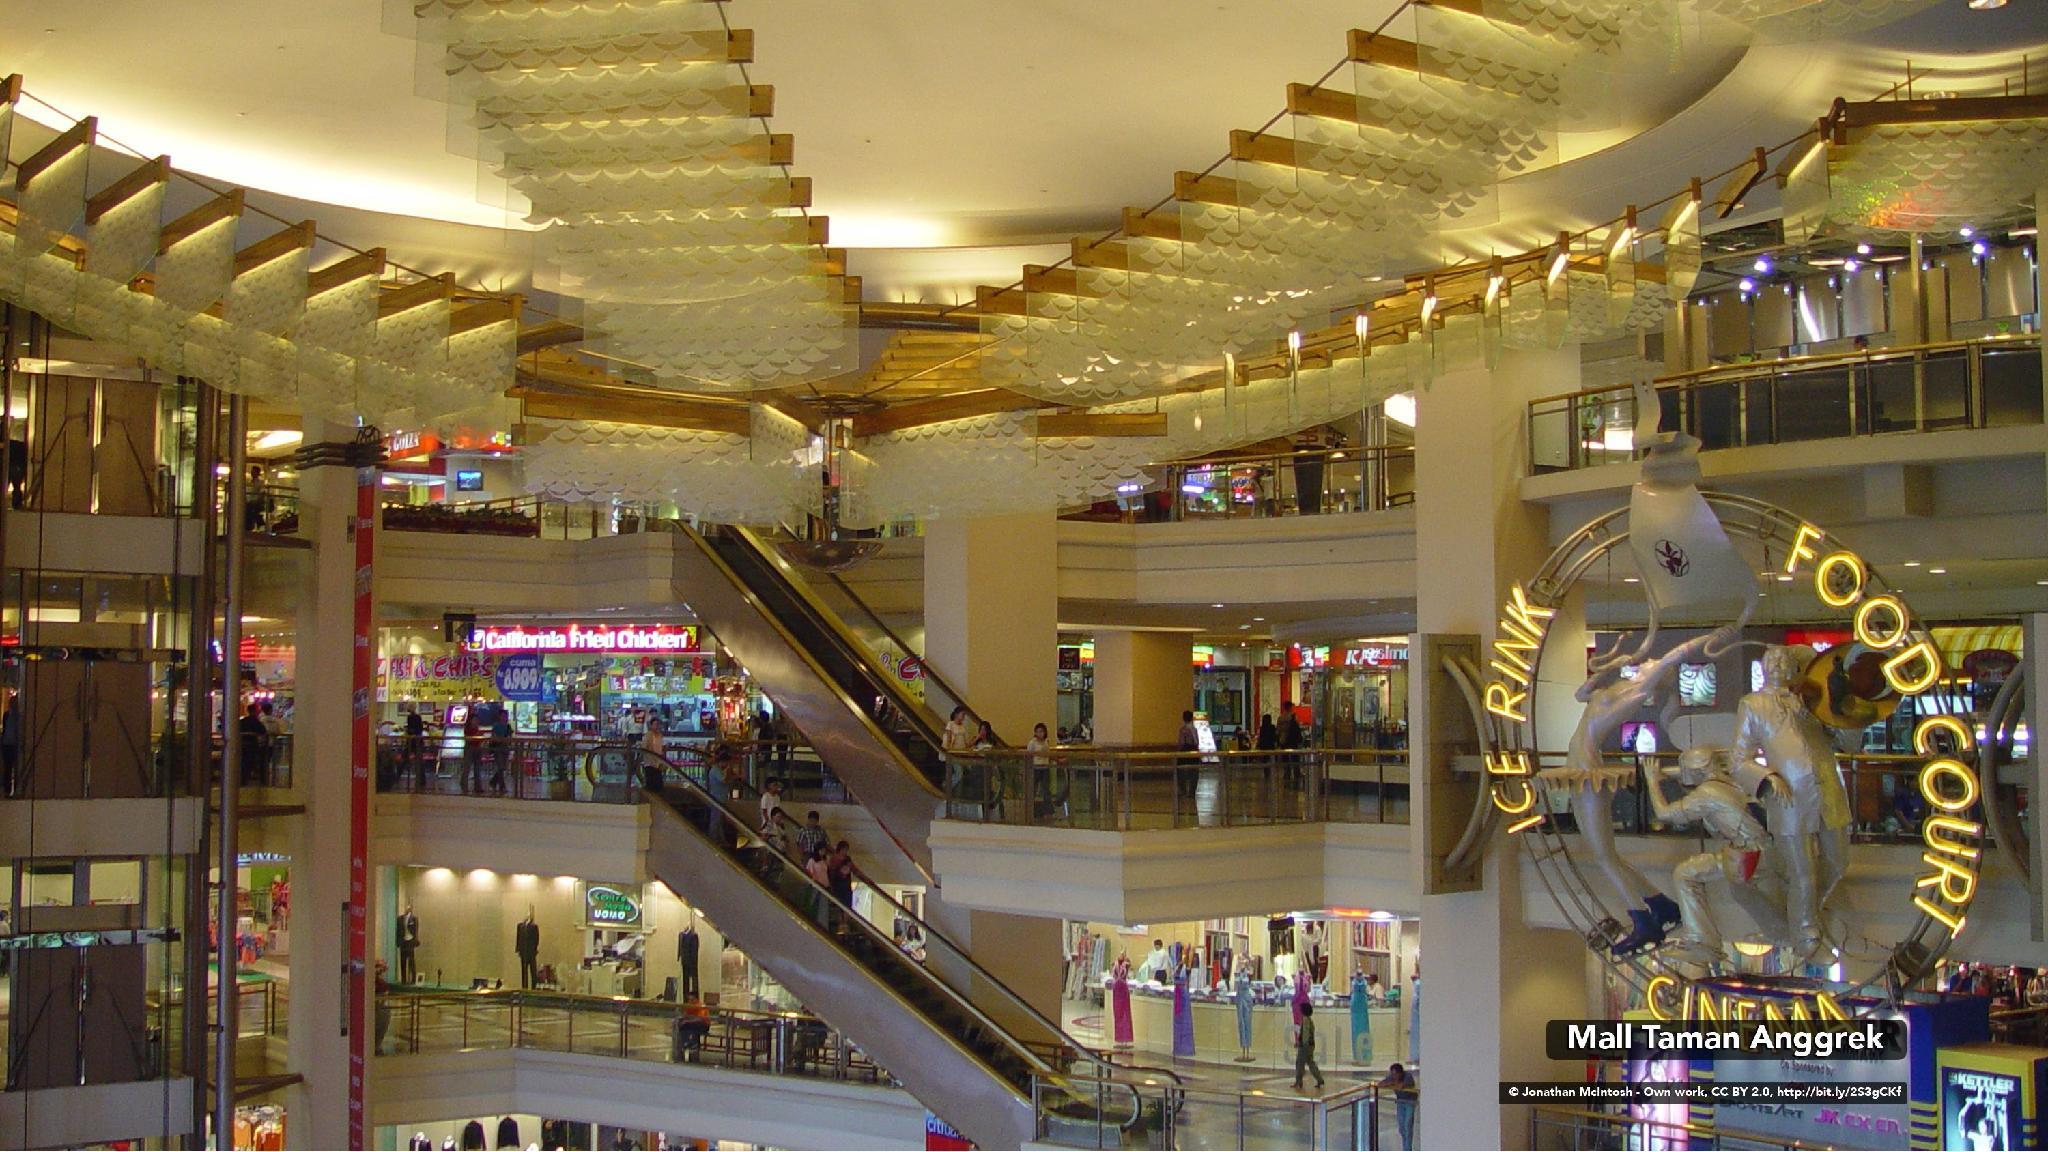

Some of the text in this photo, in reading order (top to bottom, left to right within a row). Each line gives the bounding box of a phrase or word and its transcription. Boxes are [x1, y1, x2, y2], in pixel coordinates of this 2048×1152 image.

[485, 630, 688, 648] California Fried Chicken
[432, 654, 494, 681] CHIPS
[510, 659, 536, 667] cuma
[1484, 580, 1556, 835] ICE RINK
[1784, 520, 1983, 939] FOOD COURT
[594, 909, 626, 920] UOMO
[1958, 1073, 2014, 1092] KETTLER
